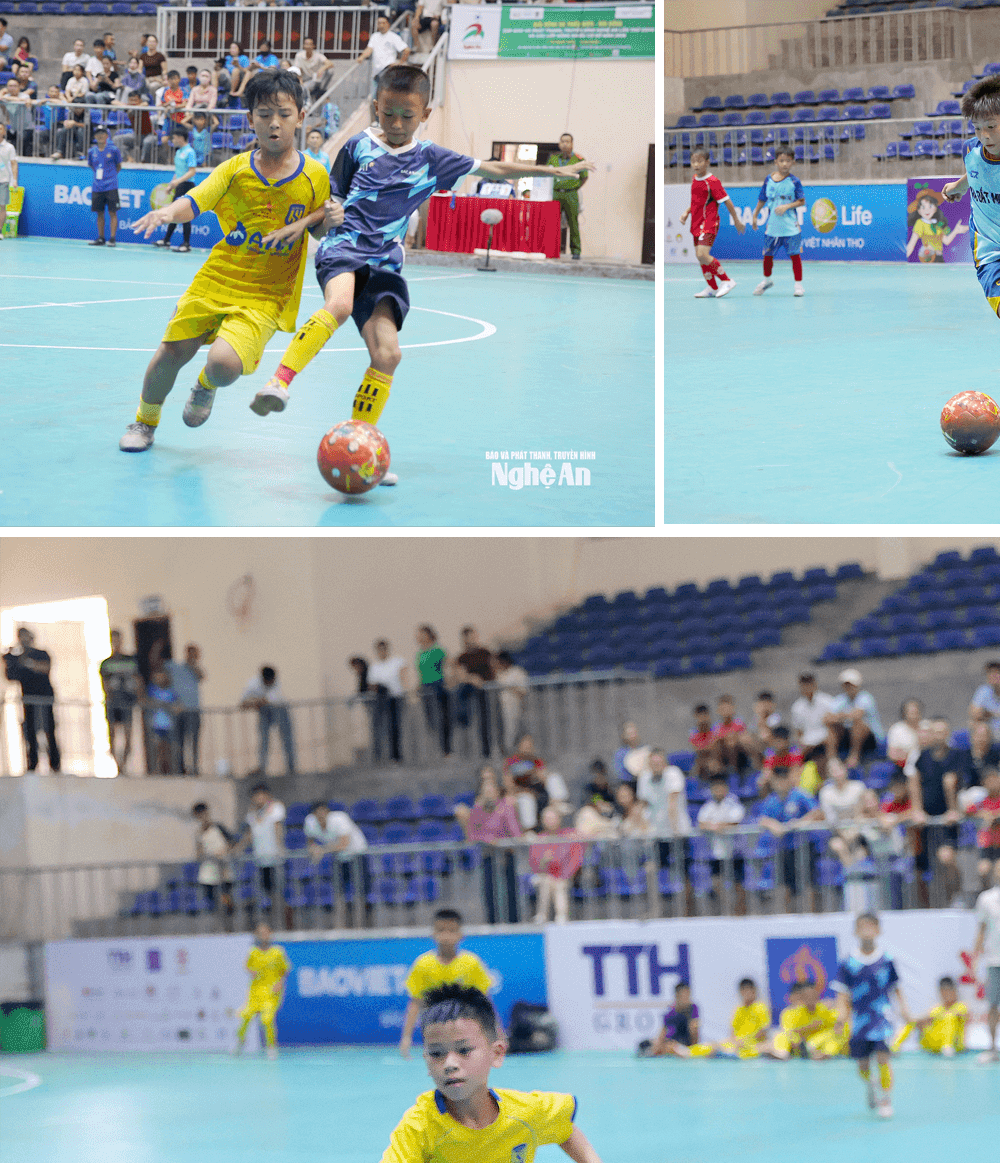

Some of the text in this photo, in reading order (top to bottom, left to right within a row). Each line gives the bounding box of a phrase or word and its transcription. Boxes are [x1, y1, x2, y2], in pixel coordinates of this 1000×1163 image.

[54, 184, 145, 209] BAOET
[841, 205, 873, 226] Life
[822, 236, 846, 249] NHÂN
[582, 942, 691, 996] TTH
